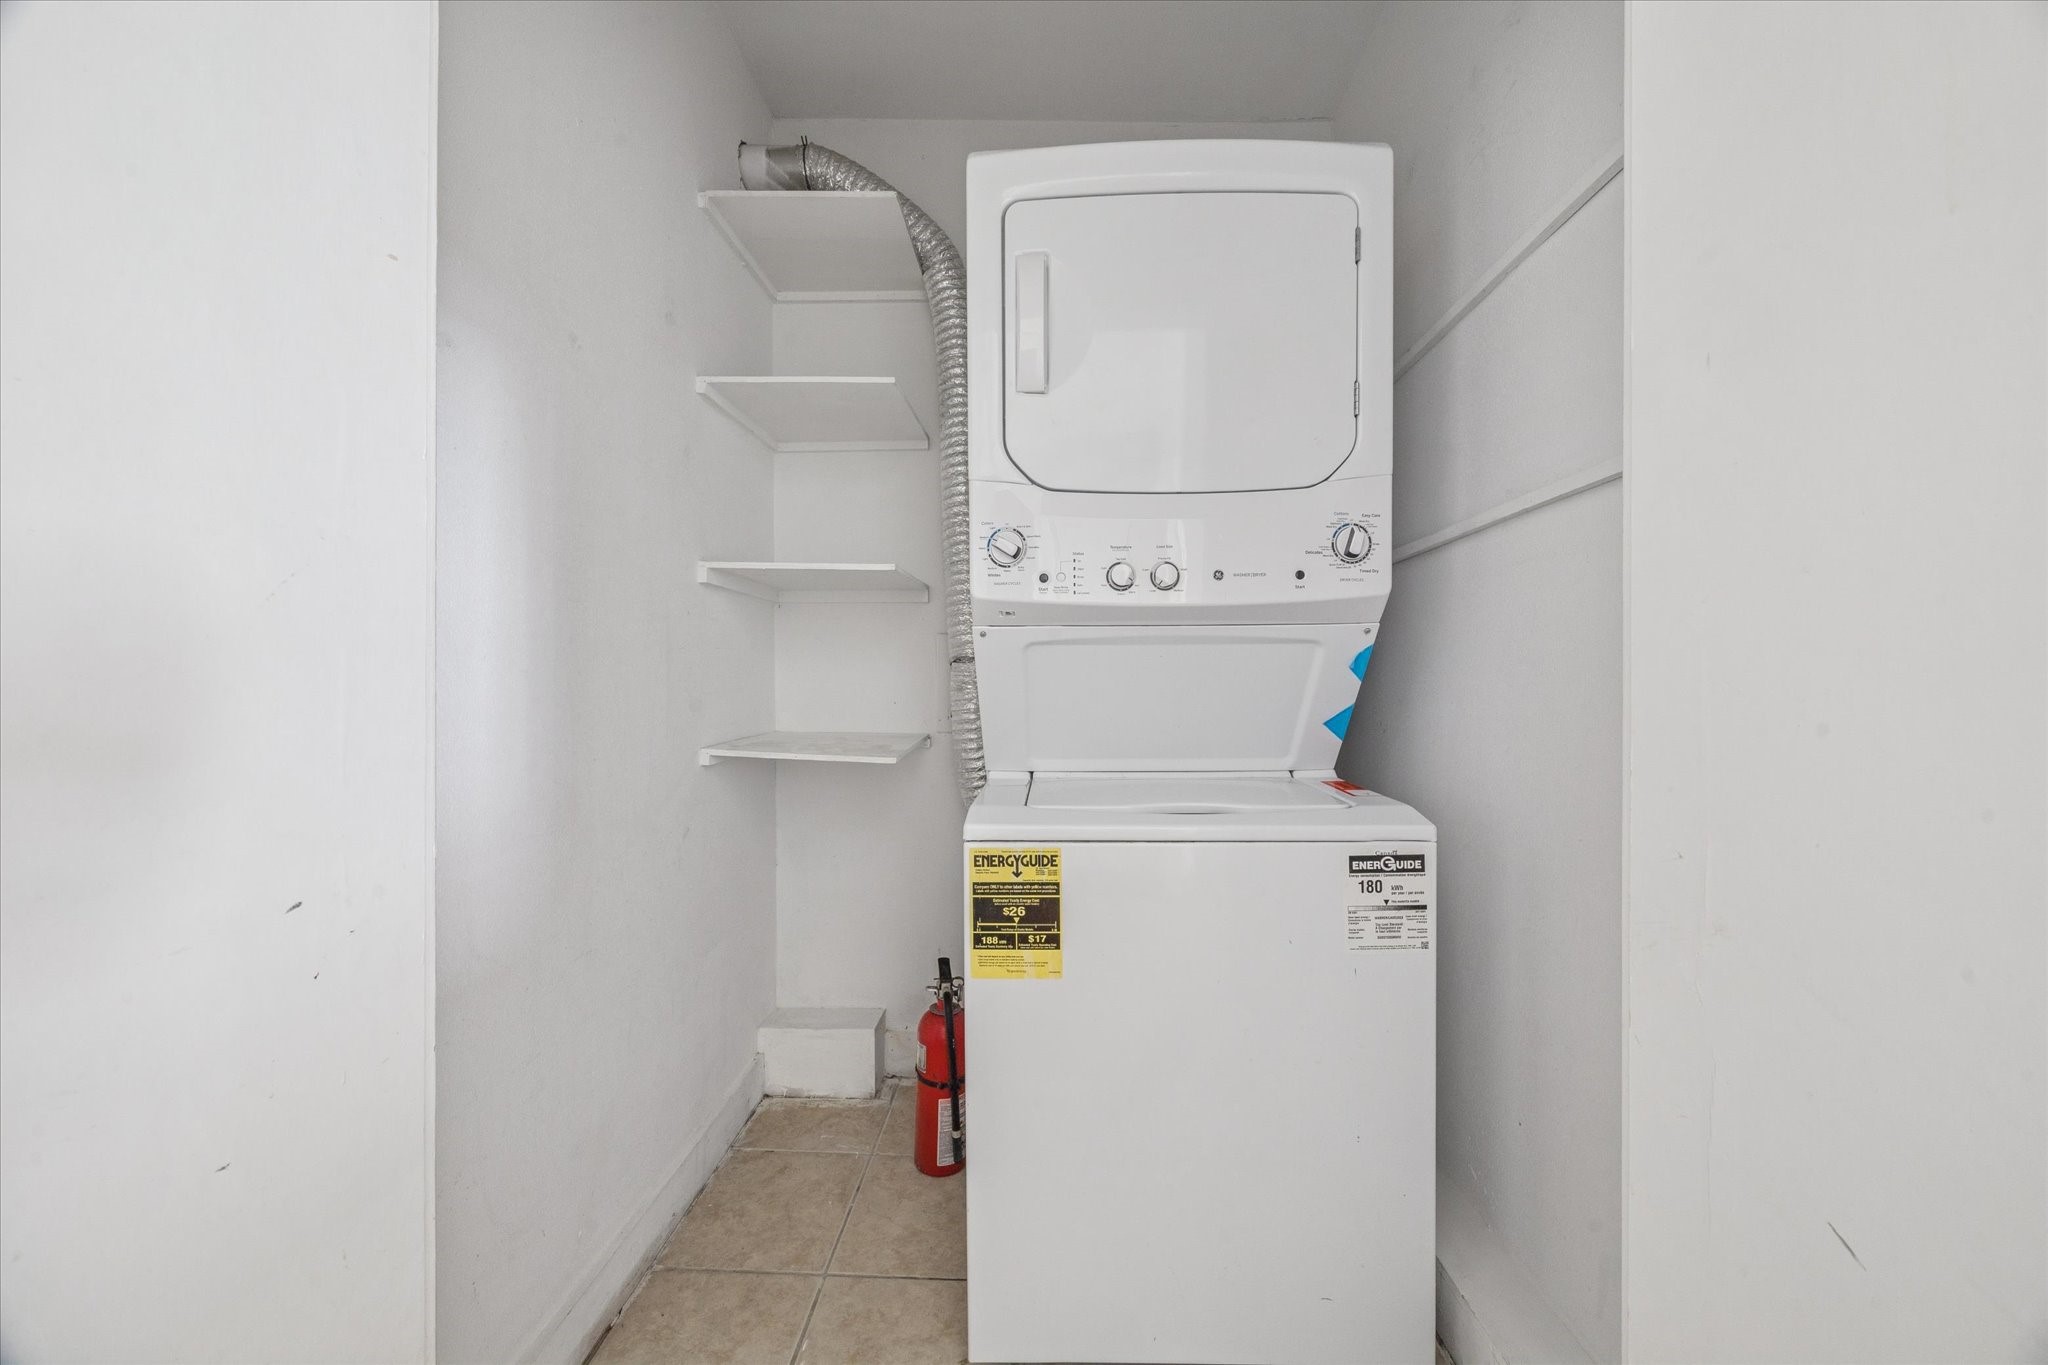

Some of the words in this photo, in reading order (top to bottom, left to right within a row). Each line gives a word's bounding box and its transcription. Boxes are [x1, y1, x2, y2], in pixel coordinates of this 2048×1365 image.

[974, 855, 1058, 868] ENERGYGUIDE
[1352, 856, 1422, 871] ENERGUIDE
[1358, 880, 1382, 893] 180
[1003, 907, 1025, 916] $26
[1028, 935, 1046, 943] $17
